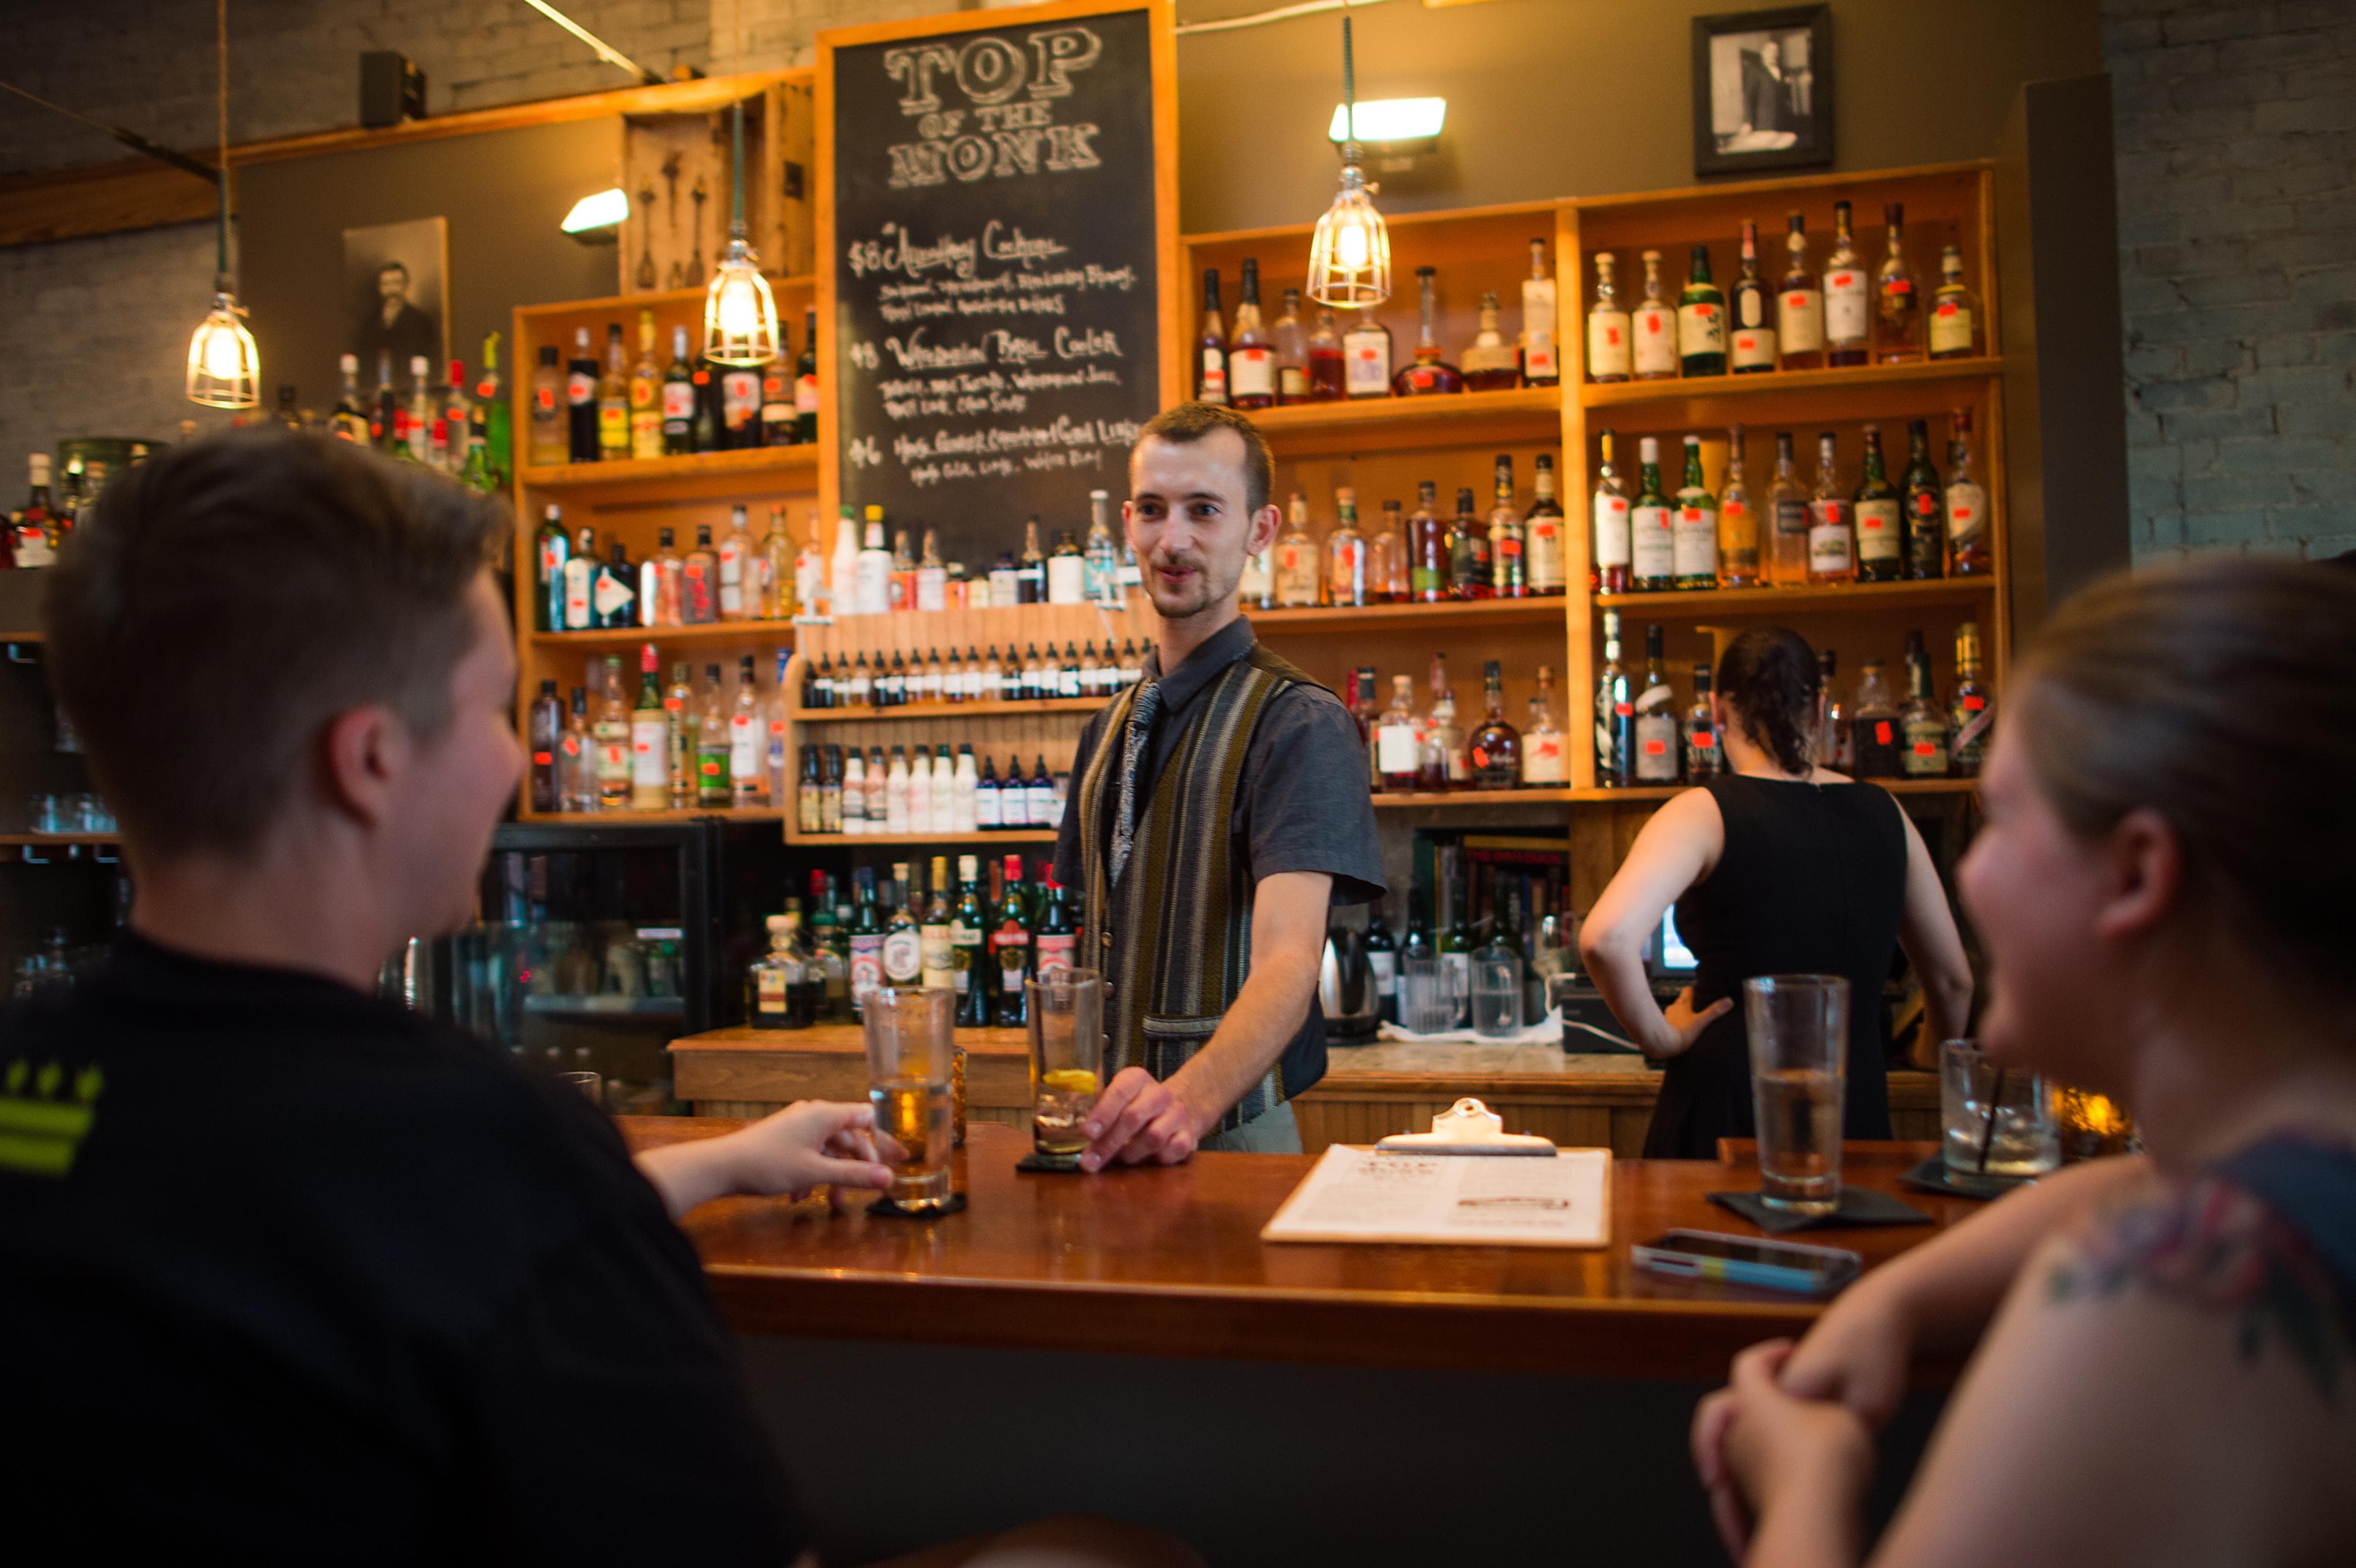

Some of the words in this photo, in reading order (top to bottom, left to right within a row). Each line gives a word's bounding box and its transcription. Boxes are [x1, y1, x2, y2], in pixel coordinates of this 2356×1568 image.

[884, 26, 1103, 115] TOP
[918, 110, 966, 139] OF
[973, 100, 1052, 133] THE
[886, 123, 1102, 190] MONK
